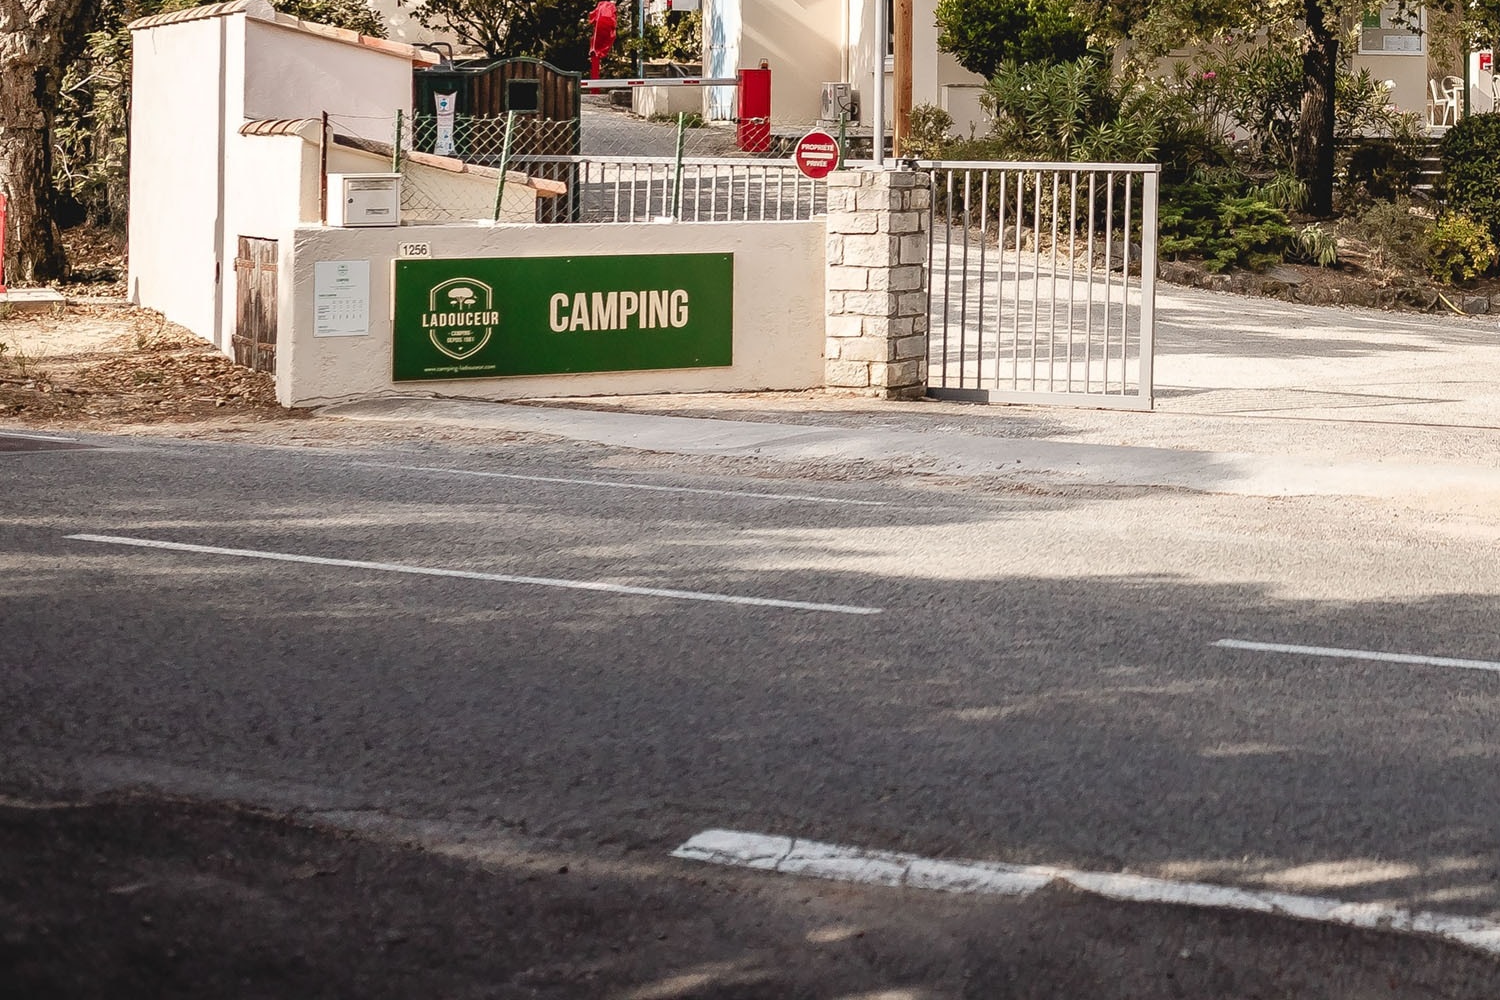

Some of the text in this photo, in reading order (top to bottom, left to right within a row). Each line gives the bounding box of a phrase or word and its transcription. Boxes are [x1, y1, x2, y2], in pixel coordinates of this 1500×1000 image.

[403, 244, 428, 255] 1256
[422, 311, 499, 328] LADOUCEUR
[549, 289, 689, 333] CAMPING
